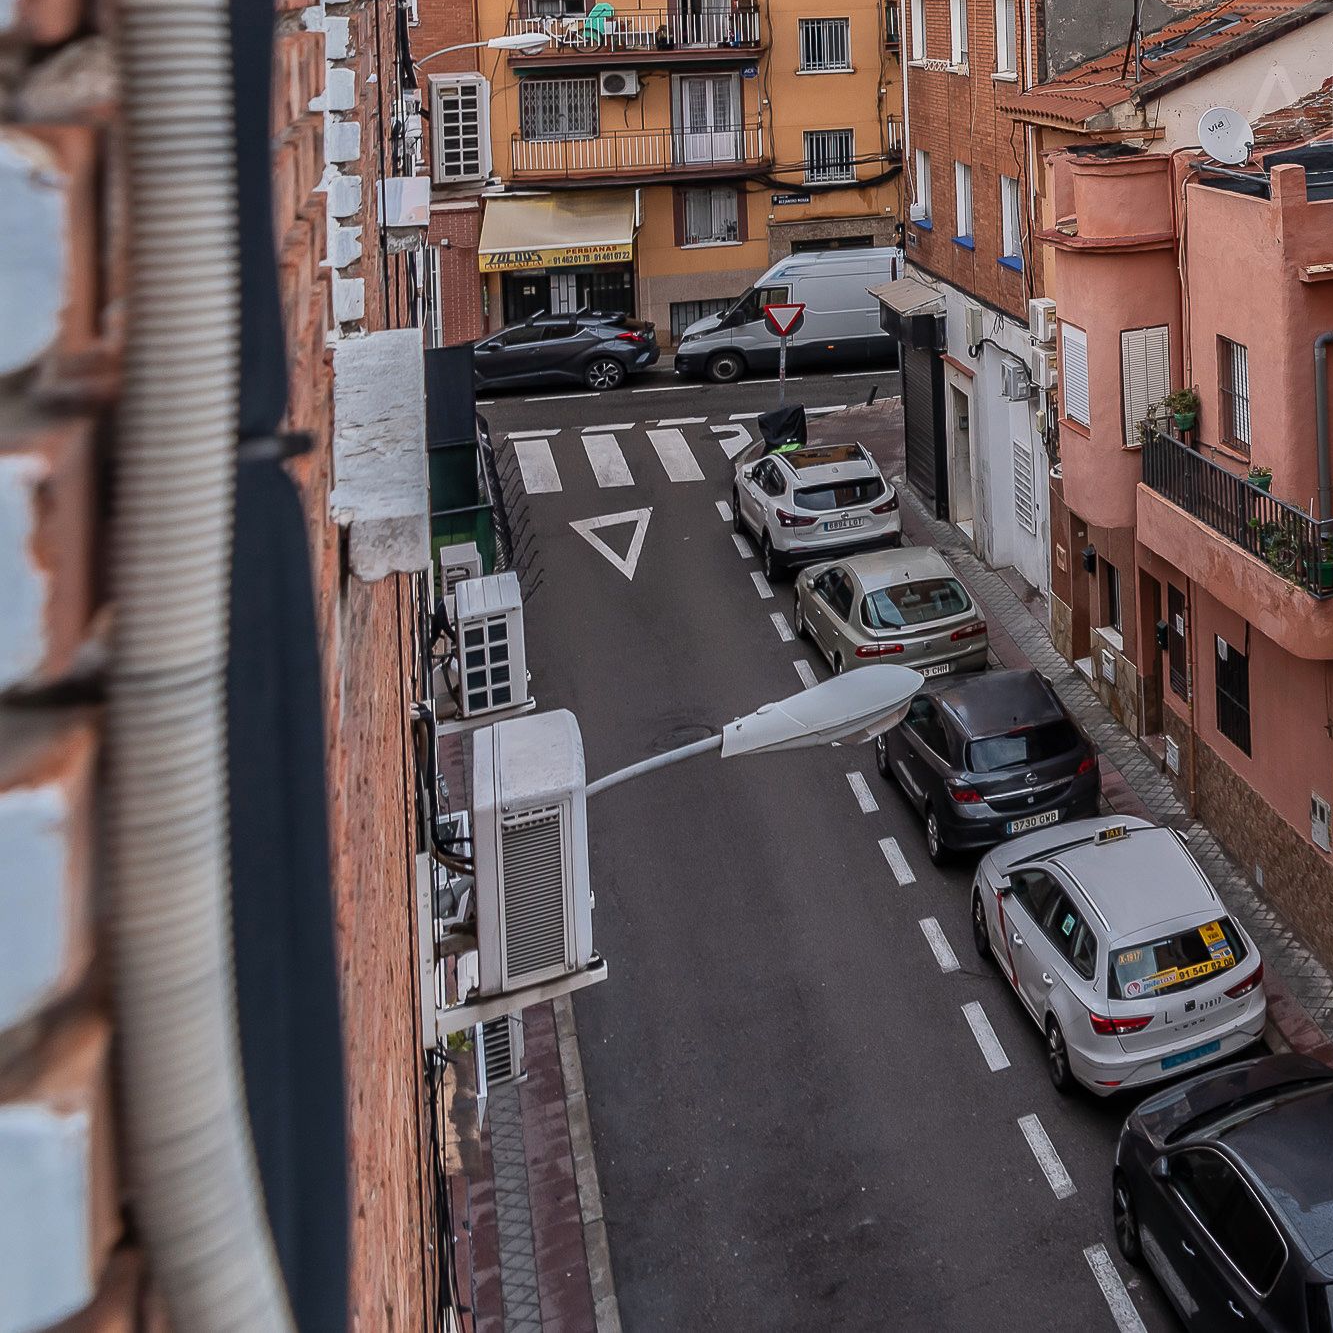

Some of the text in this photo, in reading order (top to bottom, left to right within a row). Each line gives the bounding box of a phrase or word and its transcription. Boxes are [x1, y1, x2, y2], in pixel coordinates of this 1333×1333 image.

[565, 245, 618, 254] PERSIANAS
[1013, 818, 1036, 831] 3730
[1179, 970, 1190, 980] 91
[1193, 965, 1208, 976] 547
[1224, 957, 1234, 967] 00
